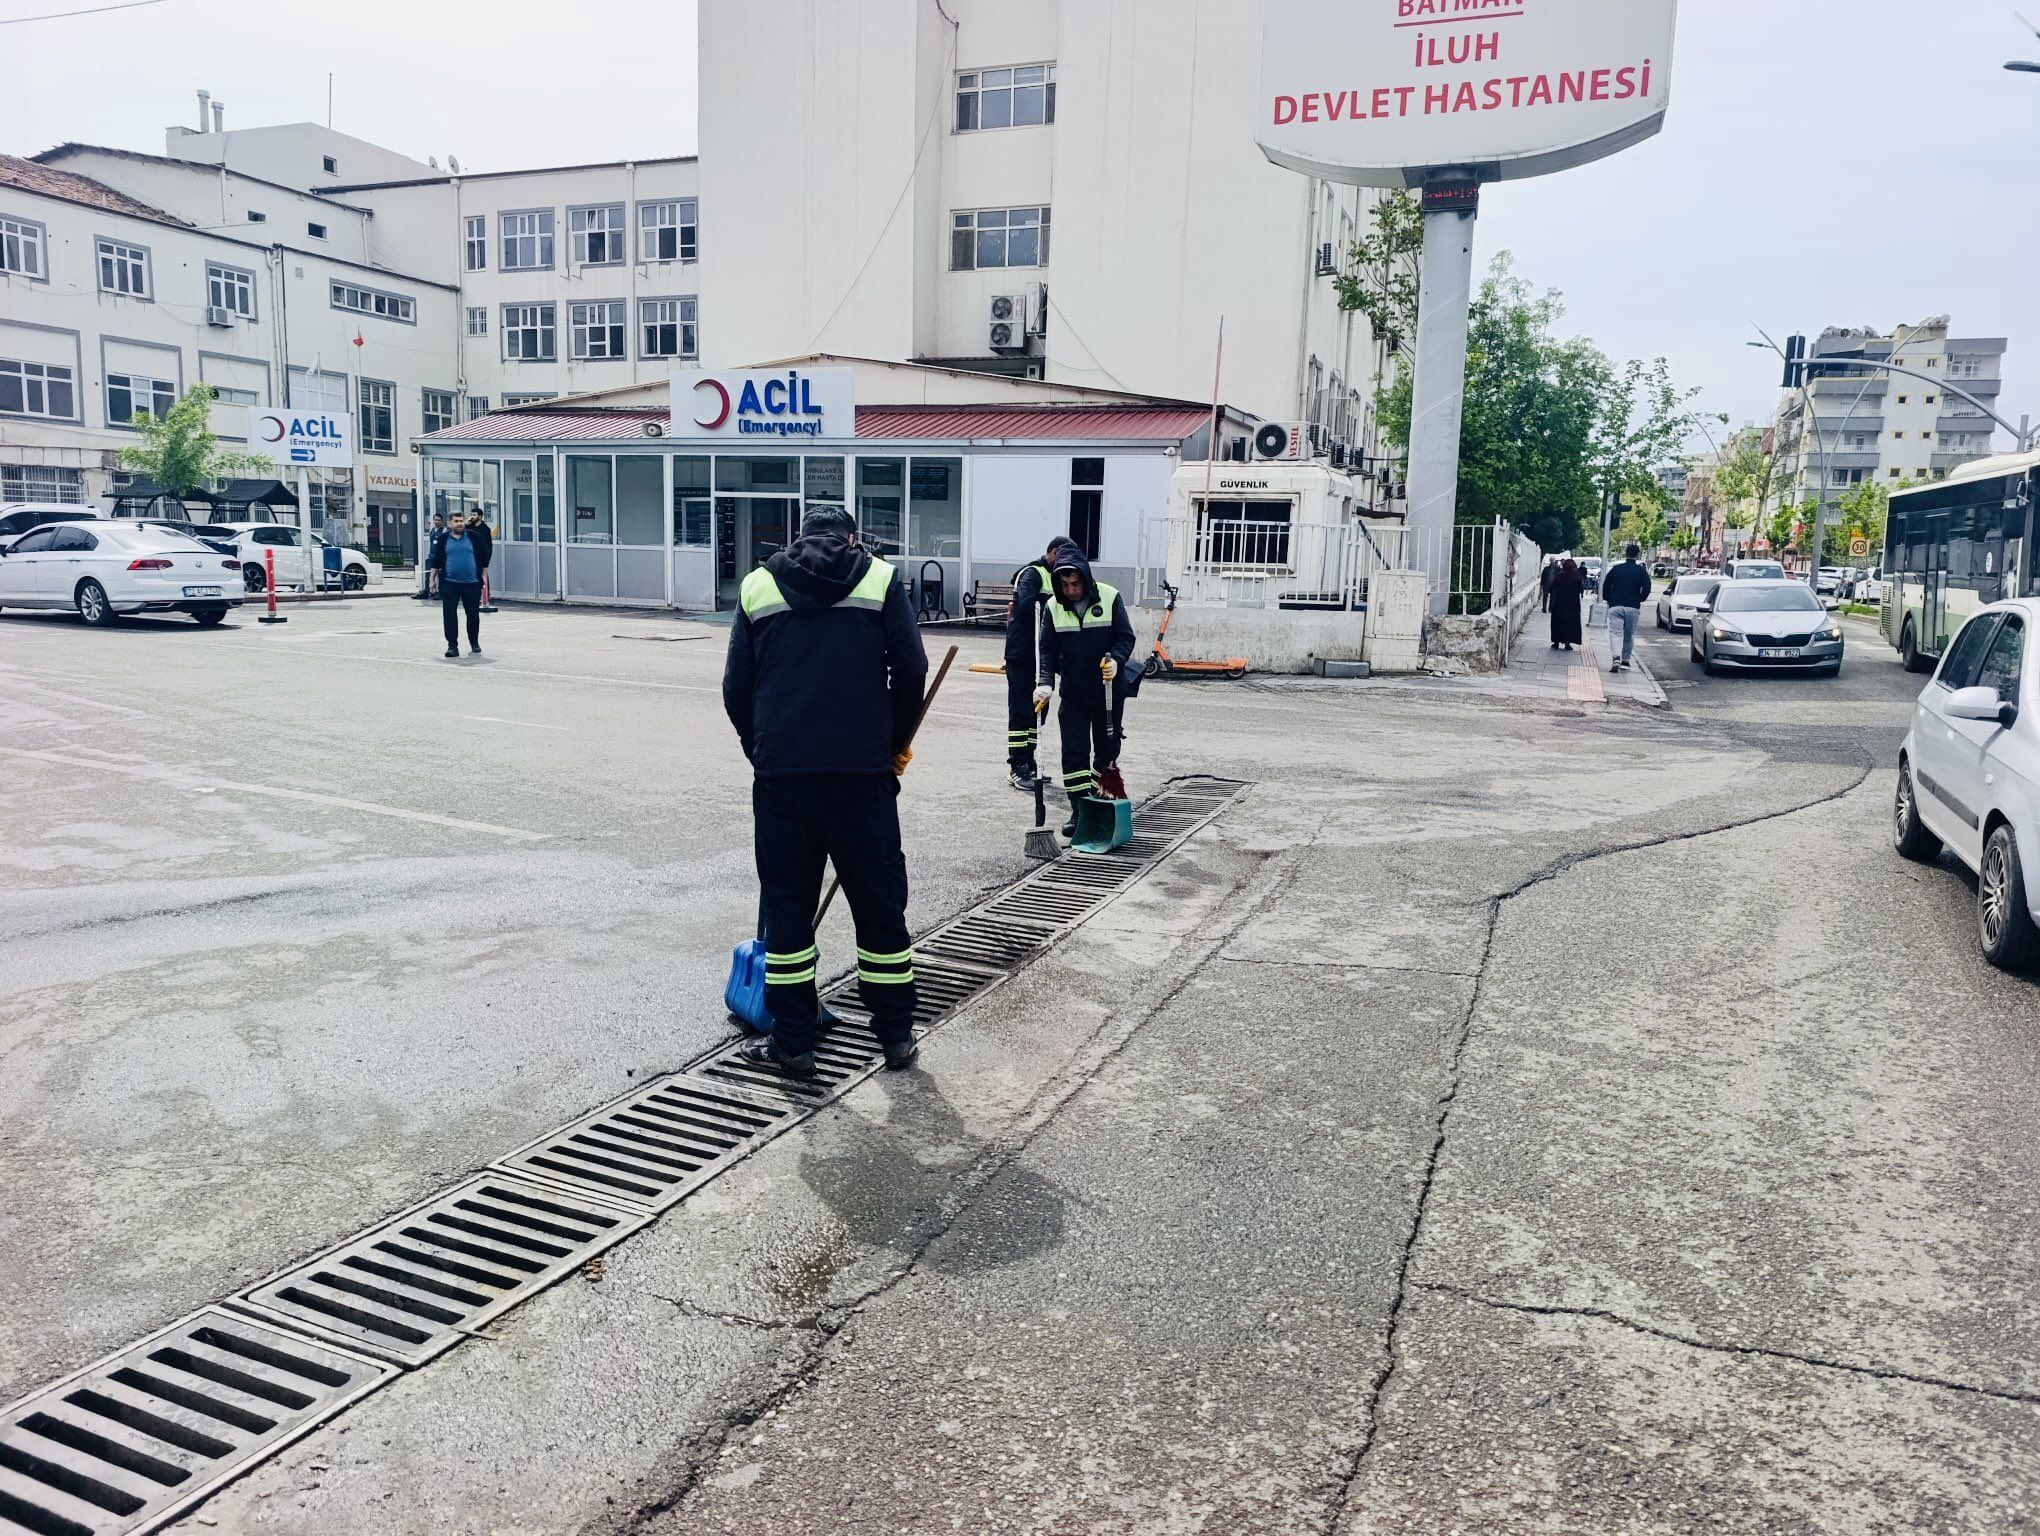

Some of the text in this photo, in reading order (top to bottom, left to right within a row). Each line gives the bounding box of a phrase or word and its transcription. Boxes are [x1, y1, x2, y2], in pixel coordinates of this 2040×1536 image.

[1414, 33, 1500, 67] İLUH
[1273, 58, 1651, 125] DEVLET HASTANESİ
[736, 371, 822, 414] ACİL
[289, 416, 342, 438] ACİL
[738, 419, 822, 436] (Emergency)
[1289, 426, 1299, 457] VESTEL
[369, 475, 409, 487] YATAKLI
[1220, 479, 1269, 489] GÜVENLİK
